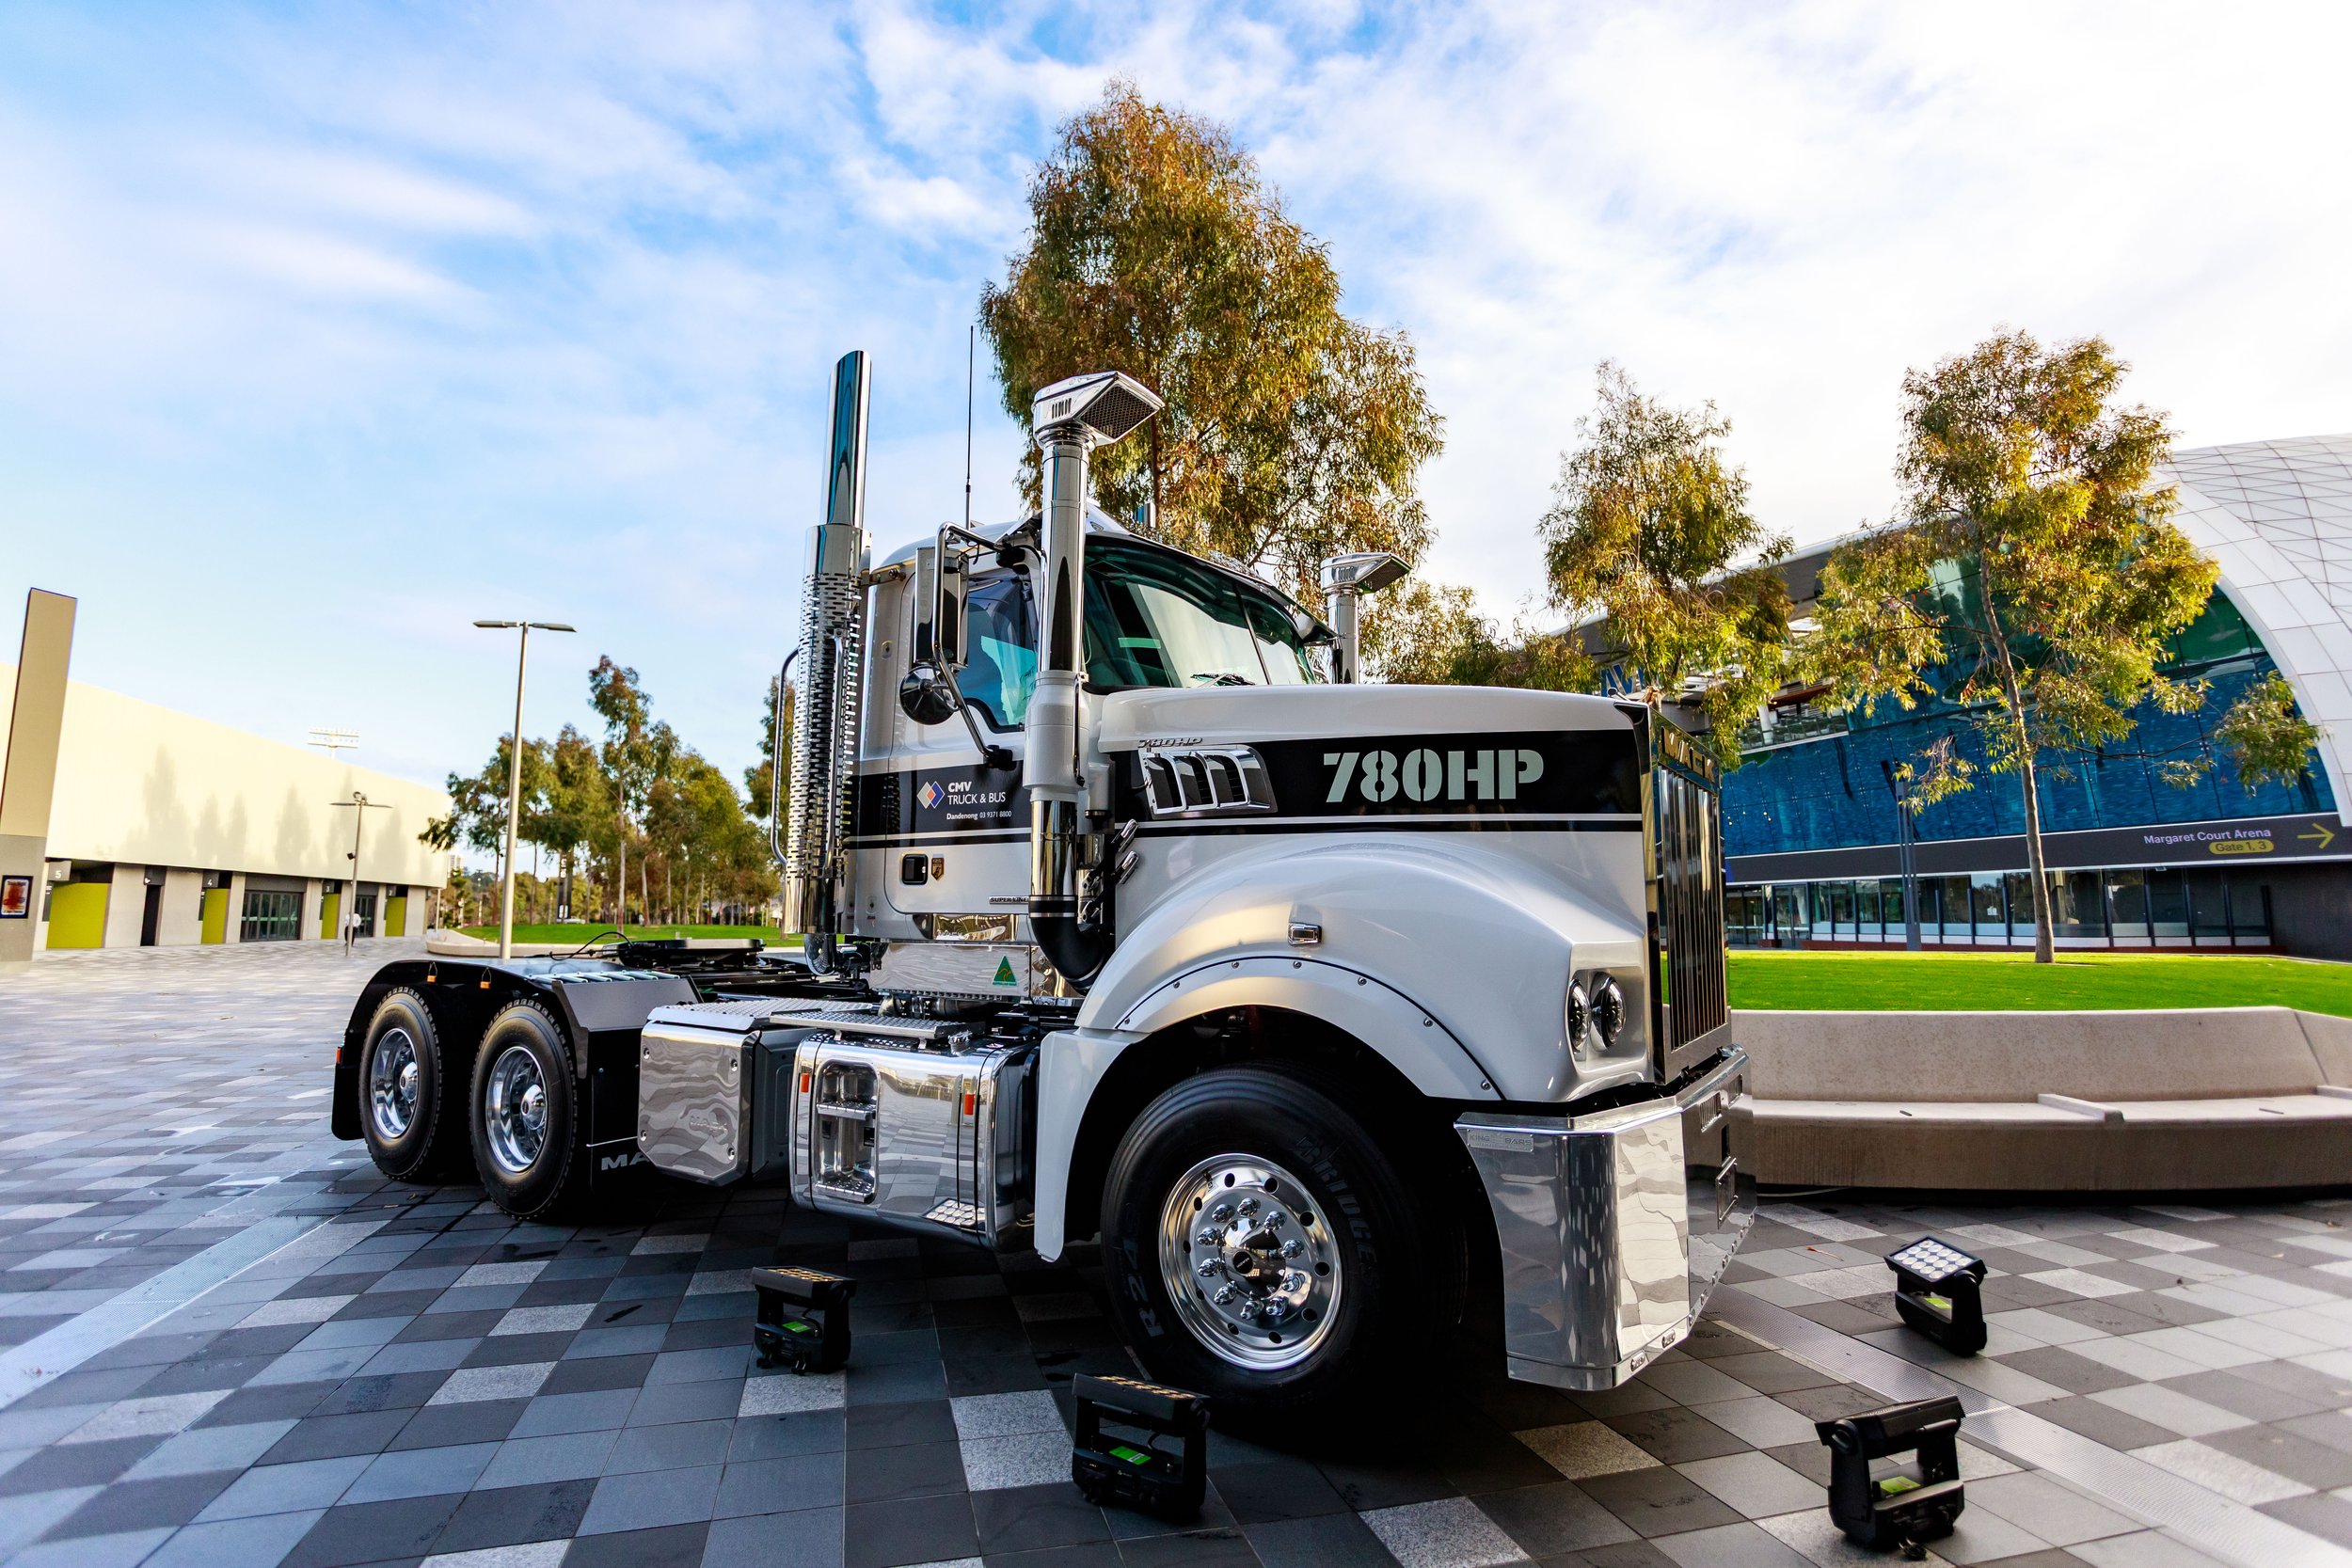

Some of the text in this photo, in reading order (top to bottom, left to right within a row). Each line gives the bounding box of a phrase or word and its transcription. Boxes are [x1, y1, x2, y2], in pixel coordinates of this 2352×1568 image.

[1137, 737, 1203, 749] 780HP
[1660, 726, 1715, 784] MACK
[1324, 748, 1545, 803] 780HP
[947, 781, 972, 793] CMV
[947, 791, 1007, 805] TRUCK & BUS
[2143, 829, 2272, 845] Margaret Court Arena
[2215, 843, 2244, 852] Gate
[2259, 841, 2267, 850] 3
[55, 870, 62, 879] 5
